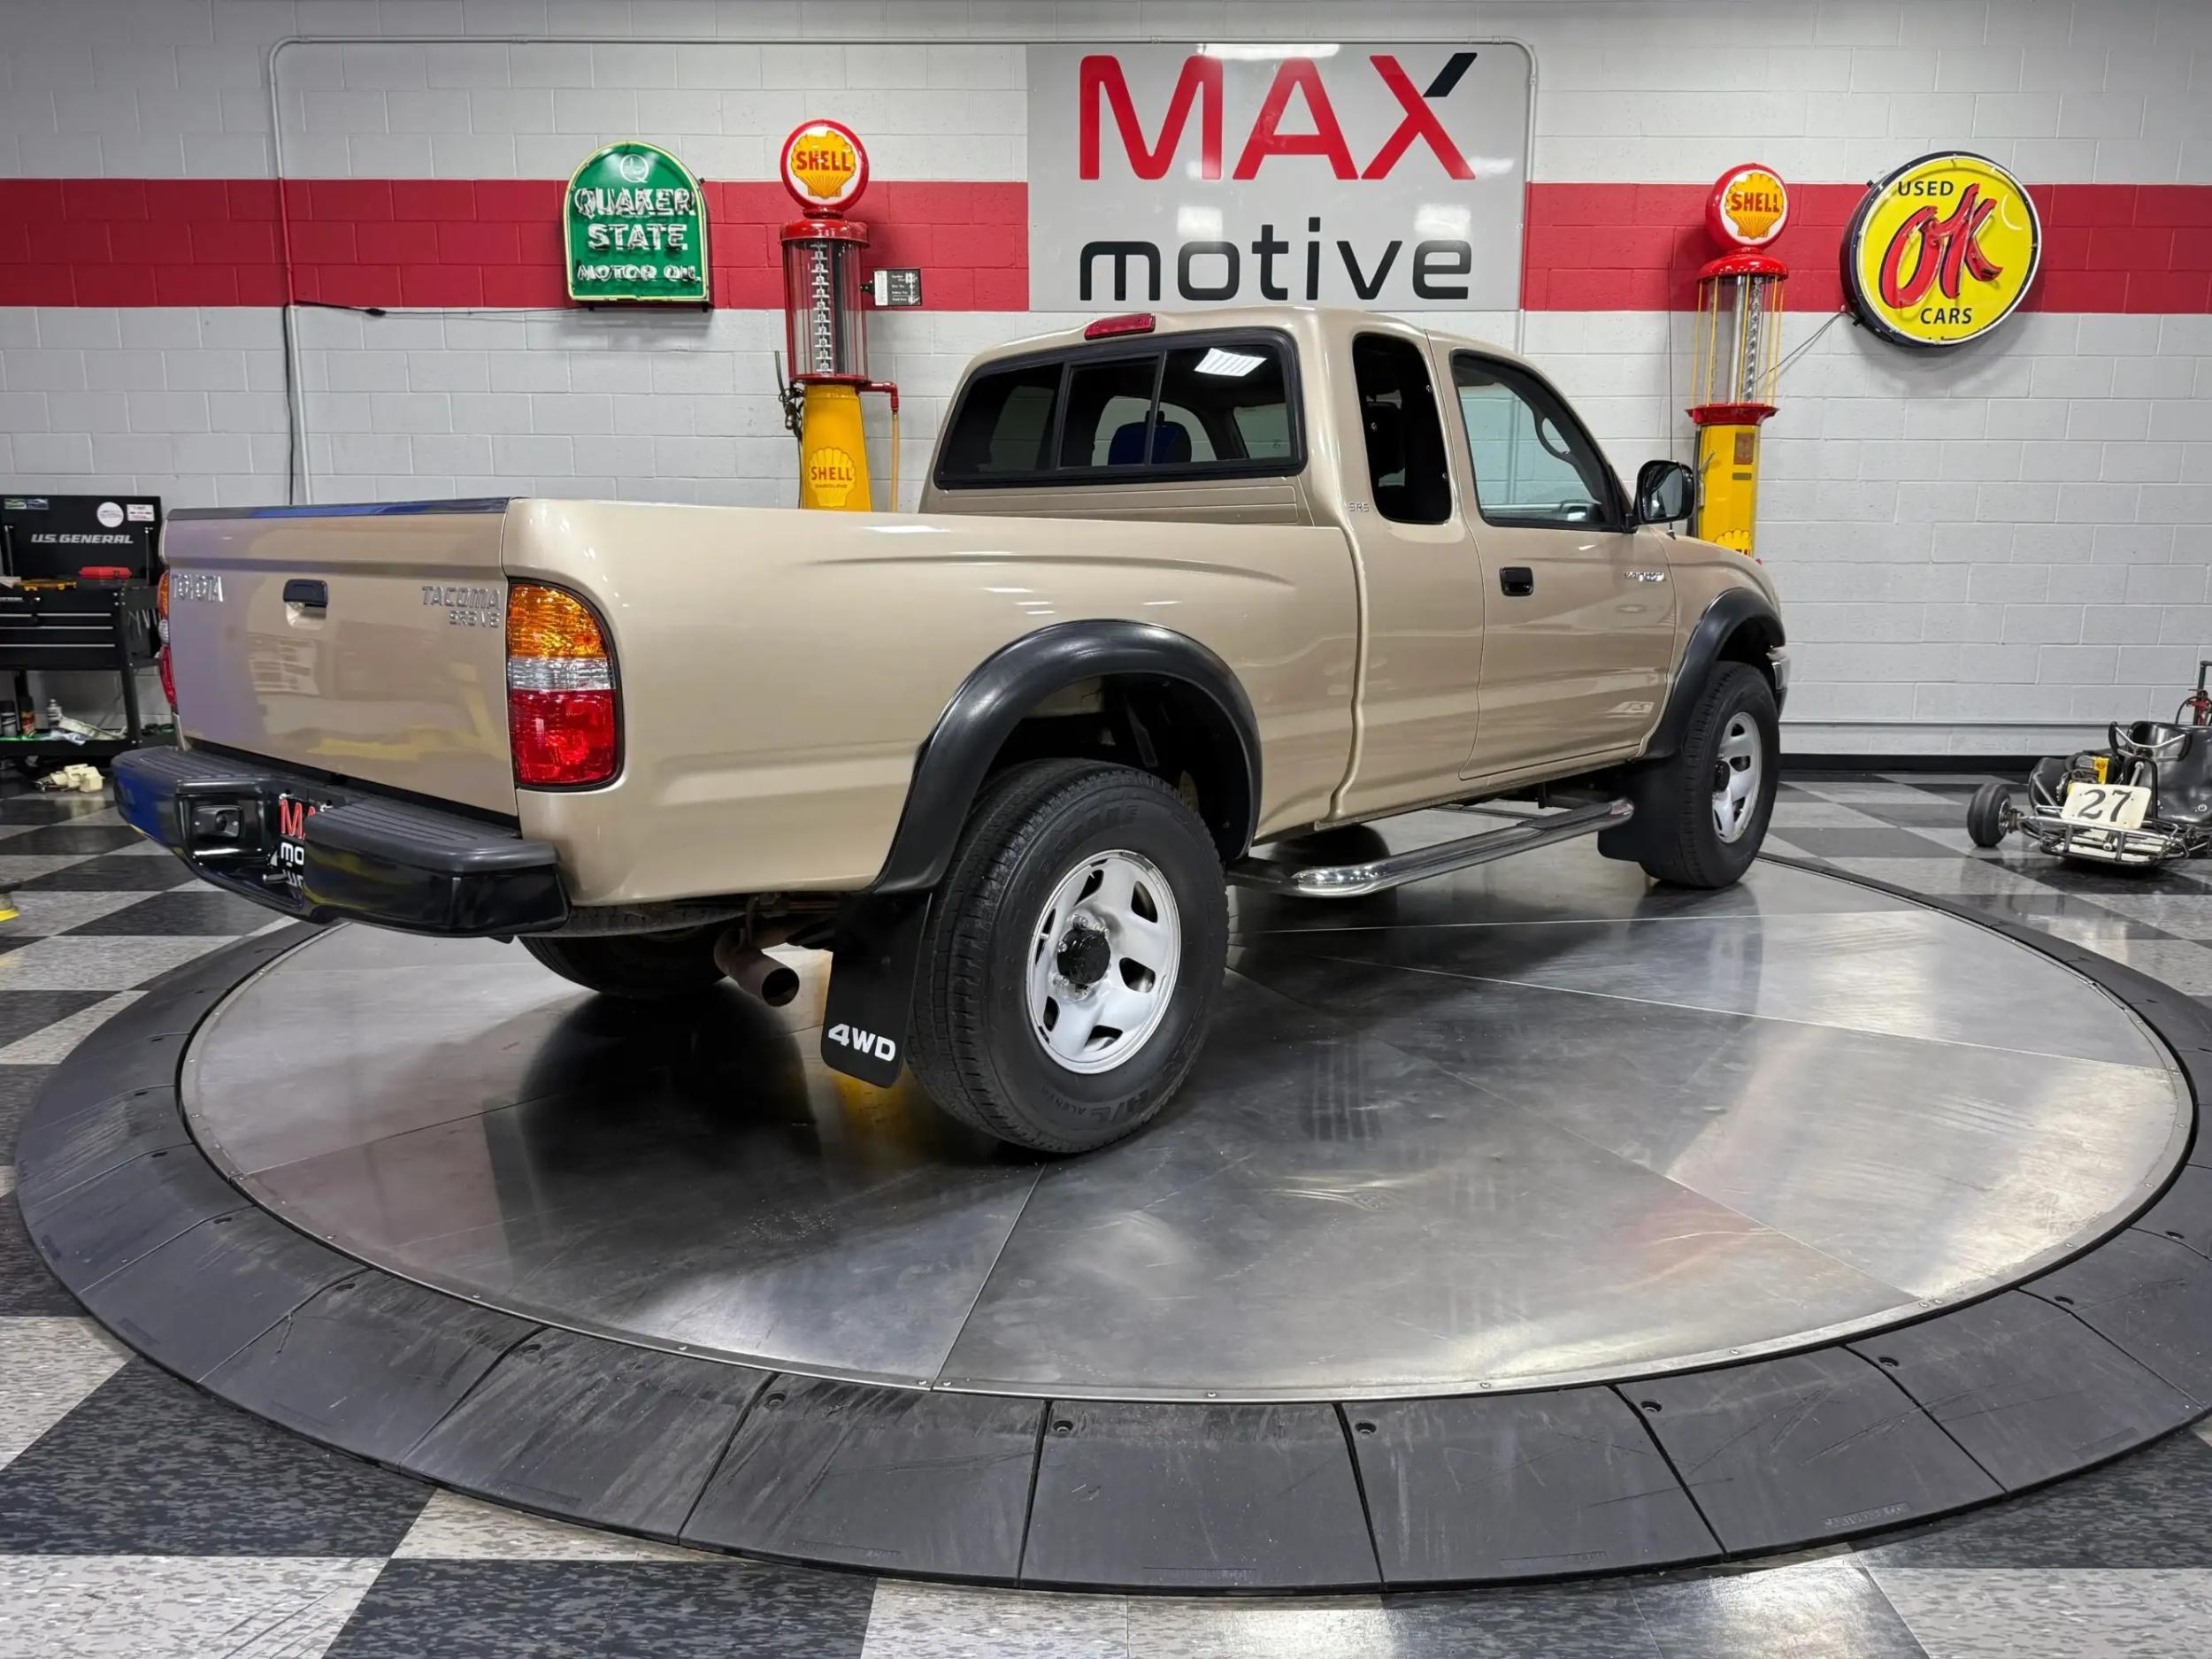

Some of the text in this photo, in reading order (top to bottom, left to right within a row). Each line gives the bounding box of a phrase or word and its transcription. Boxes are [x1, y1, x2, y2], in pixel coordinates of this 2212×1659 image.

[1079, 52, 1478, 180] MAX
[796, 150, 851, 172] SHELL
[1897, 180, 1954, 196] USED
[575, 187, 696, 219] QUAKER
[1731, 192, 1780, 213] SHELL
[588, 224, 688, 250] STATE
[1878, 183, 2004, 309] OK
[1079, 217, 1471, 301] motive
[577, 265, 702, 283] MOTOR OIL
[1920, 308, 1972, 325] CARS
[811, 466, 853, 480] SHELL
[58, 534, 134, 544] GENERAL
[422, 586, 501, 610] TACOMA
[2078, 788, 2133, 823] 27
[828, 1023, 896, 1062] 4WD
